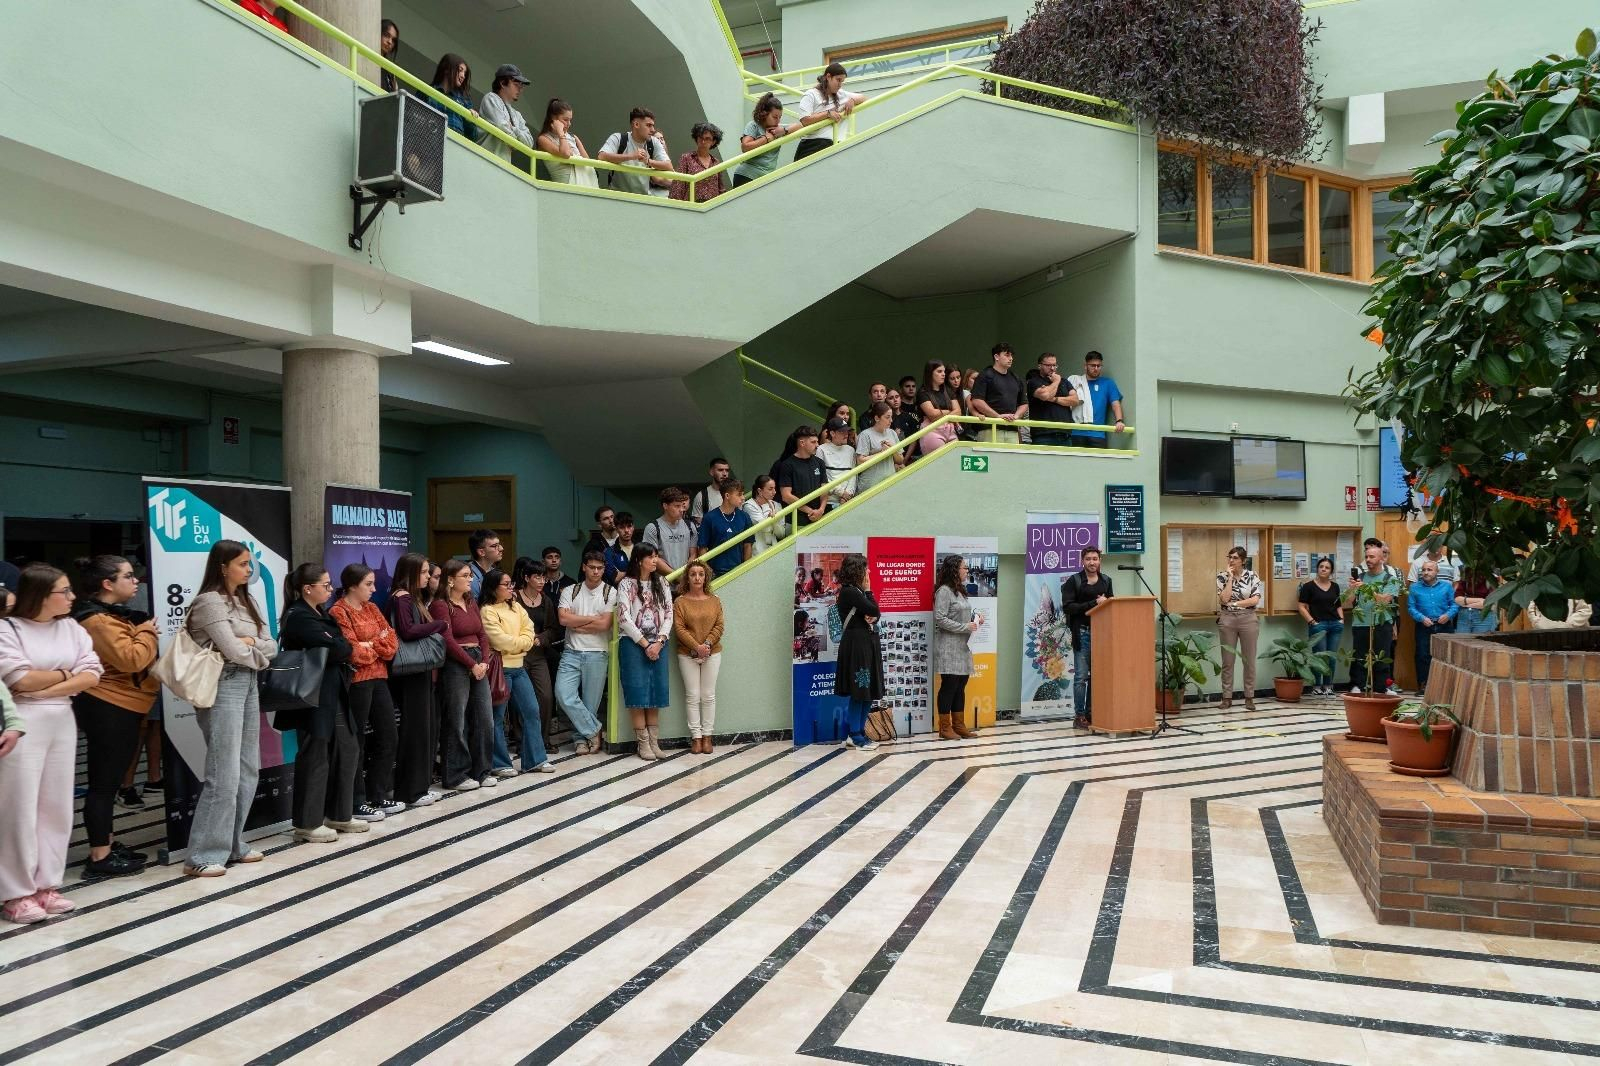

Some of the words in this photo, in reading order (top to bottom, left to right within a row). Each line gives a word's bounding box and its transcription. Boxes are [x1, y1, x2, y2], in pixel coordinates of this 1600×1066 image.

[149, 488, 187, 541] TIF
[332, 504, 386, 528] MANADAS
[387, 508, 408, 529] ALFA
[1032, 527, 1091, 547] PUNTO
[1028, 549, 1083, 570] VIOLET
[894, 567, 922, 576] SUEÑOS
[812, 672, 837, 681] COLEGI
[809, 689, 835, 697] COMPLE
